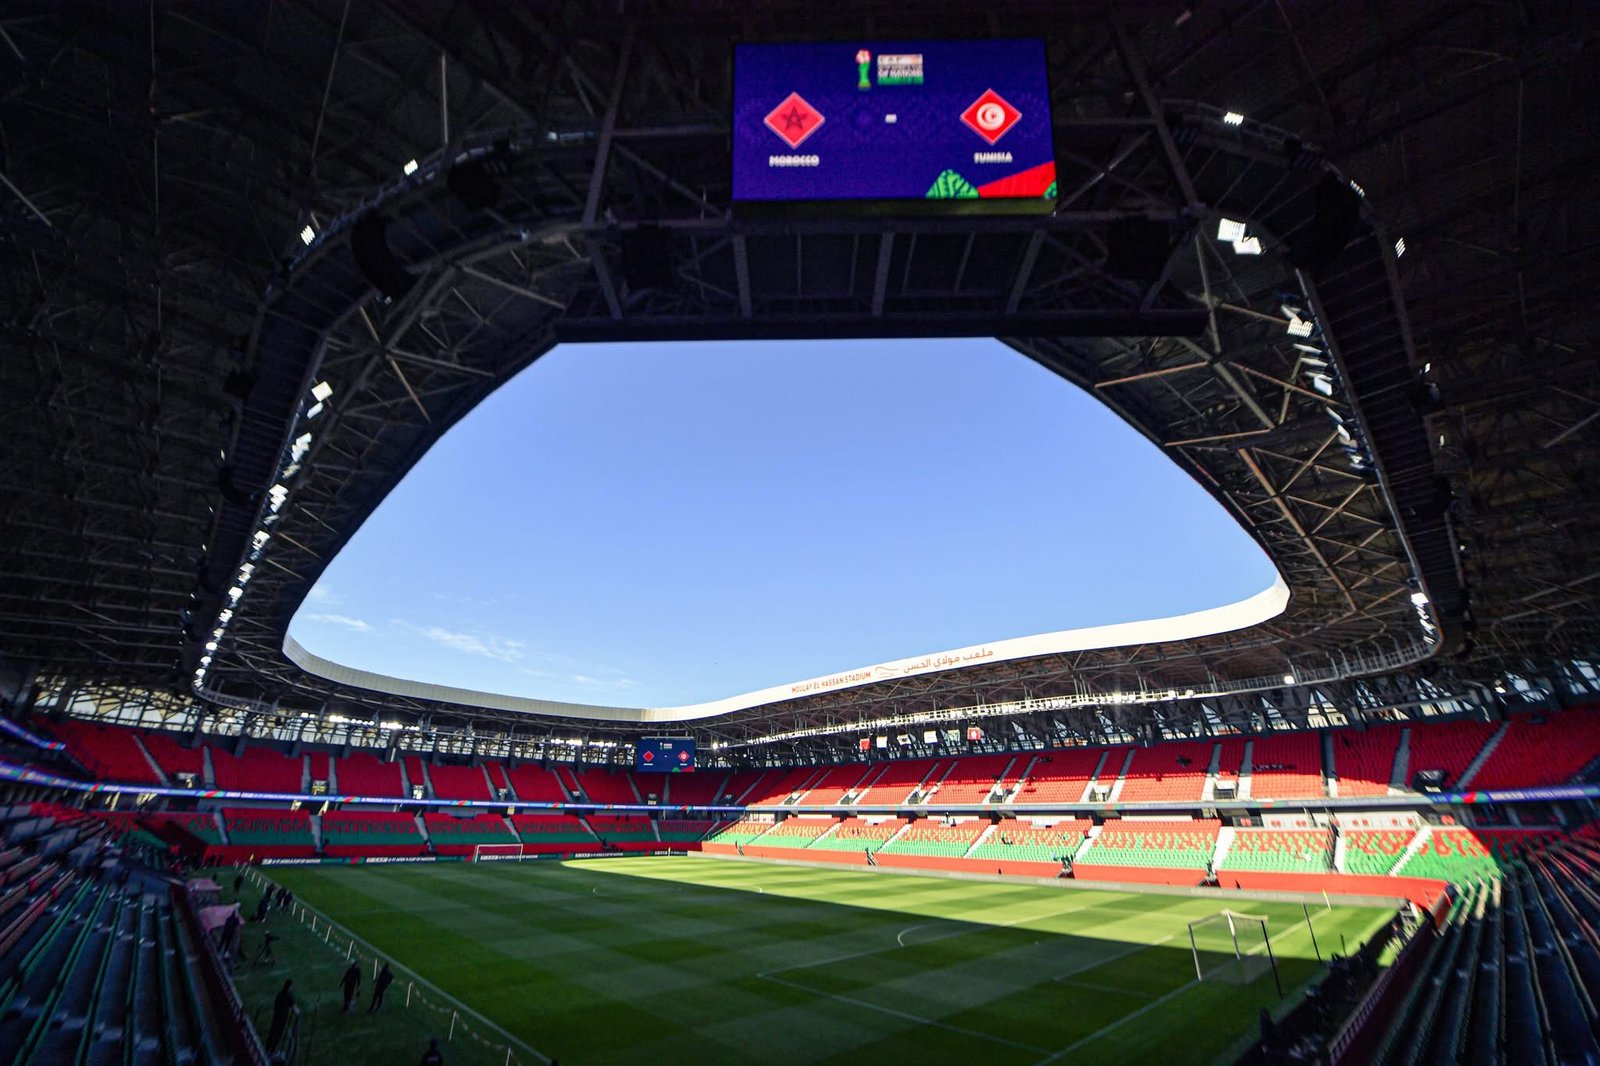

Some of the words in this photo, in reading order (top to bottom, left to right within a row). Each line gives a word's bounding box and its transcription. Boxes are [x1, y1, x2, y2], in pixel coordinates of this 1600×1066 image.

[769, 155, 820, 167] MOROCCO
[974, 152, 1013, 164] TUNISIA
[933, 655, 960, 669] مولاي
[963, 648, 993, 662] ملعب
[903, 659, 931, 673] الحسن
[821, 677, 844, 687] HASSAN
[845, 671, 871, 684] STADIUM
